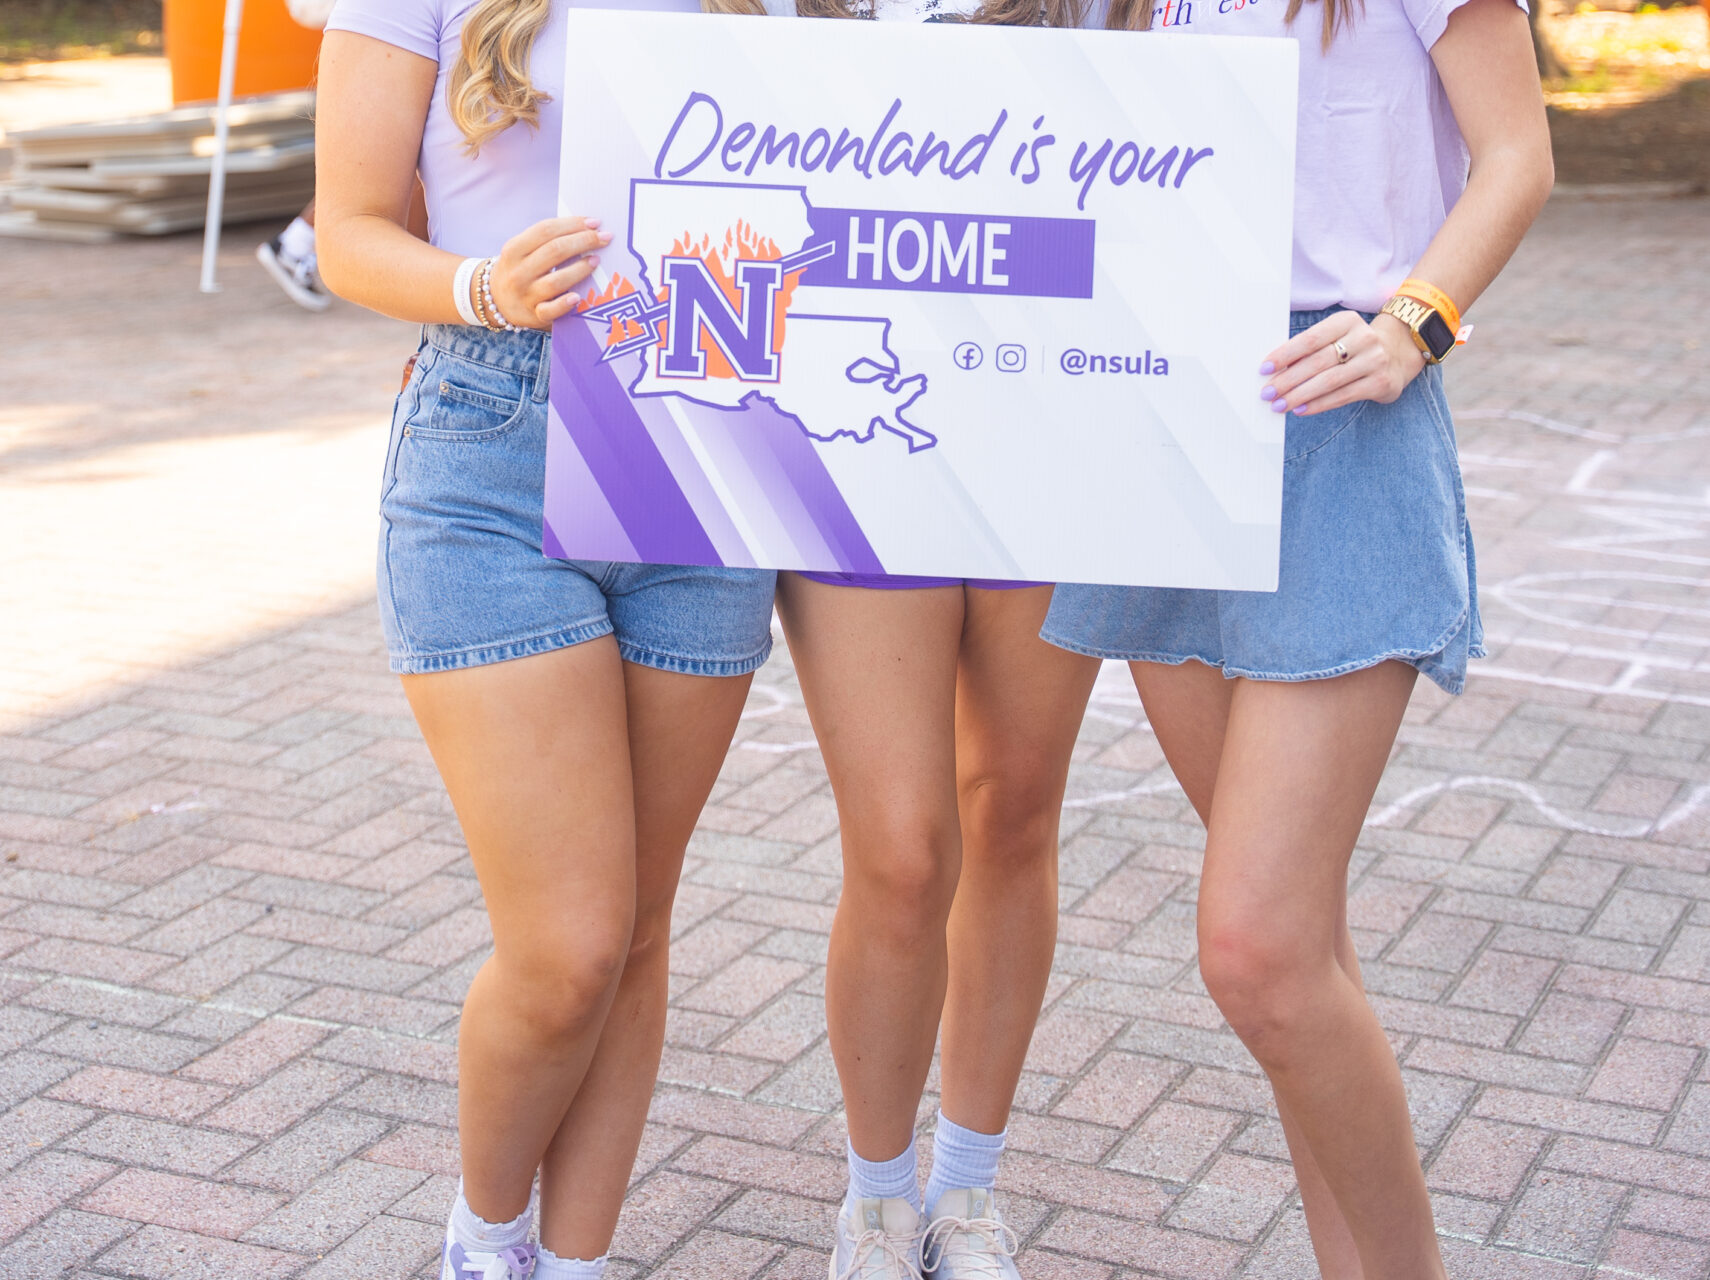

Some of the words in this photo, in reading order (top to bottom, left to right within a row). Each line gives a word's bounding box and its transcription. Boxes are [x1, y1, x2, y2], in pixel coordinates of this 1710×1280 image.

[654, 91, 1007, 180] Demonland
[1006, 111, 1057, 185] is
[1068, 137, 1215, 212] your
[846, 215, 1012, 287] HOME
[657, 255, 784, 383] N
[1059, 347, 1169, 377] @nsula
